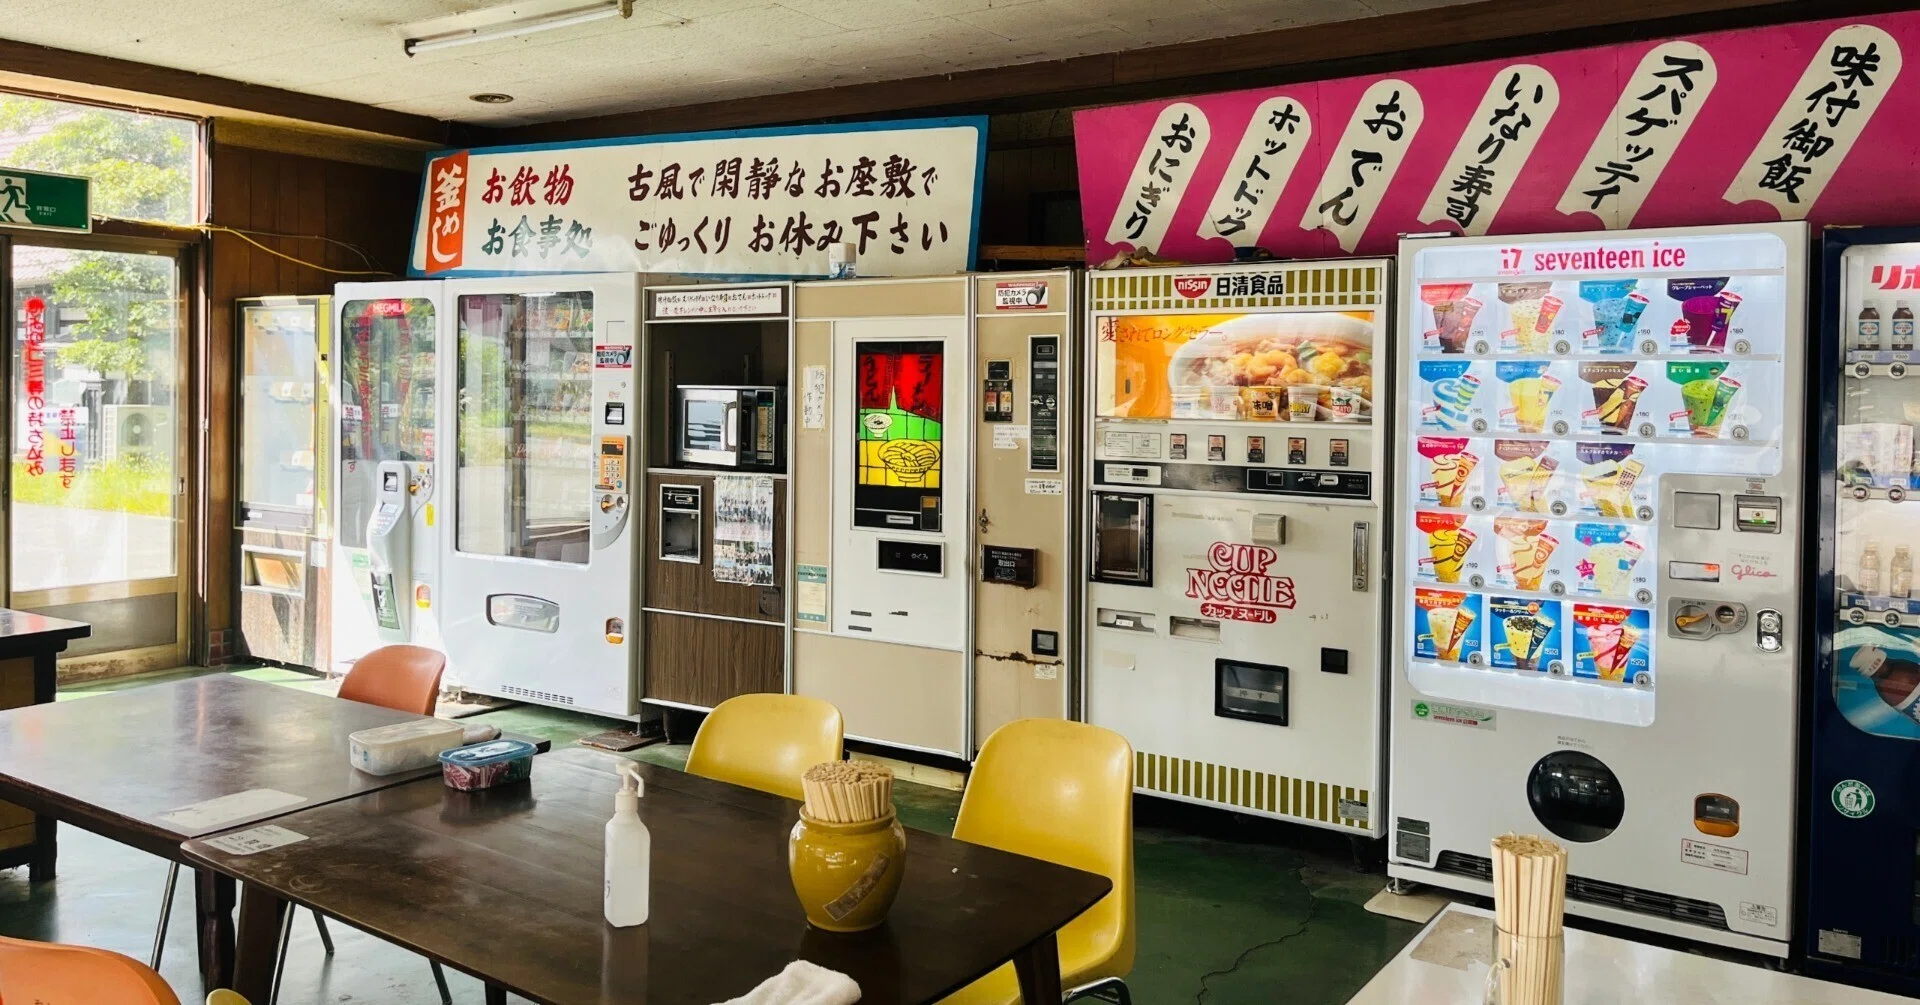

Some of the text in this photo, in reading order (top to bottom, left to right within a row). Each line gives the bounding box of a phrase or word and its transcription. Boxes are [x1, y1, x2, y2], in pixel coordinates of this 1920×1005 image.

[1581, 55, 1704, 210] スパゲッティ
[1758, 42, 1881, 204] 味付御飯
[1217, 103, 1300, 237] ホットドッグ
[1318, 90, 1407, 226] おでん
[1446, 73, 1543, 228] いなり寿司
[482, 164, 575, 206] お飲物
[1125, 113, 1196, 240] おにぎり
[431, 163, 466, 263] 釜めし
[633, 211, 949, 257] ごゆっくり お休み下さい
[481, 214, 593, 260] お食事処
[1534, 246, 1645, 271] seventeen
[1652, 241, 1686, 268] ice
[998, 289, 1027, 297] 防犯カメラ
[1002, 297, 1022, 305] 監視中
[1216, 274, 1283, 296] 日清食品
[1208, 541, 1277, 575] CUP
[1731, 564, 1777, 581] Glico
[1185, 567, 1297, 609] NOODLE
[1204, 603, 1273, 623] カップヌードル
